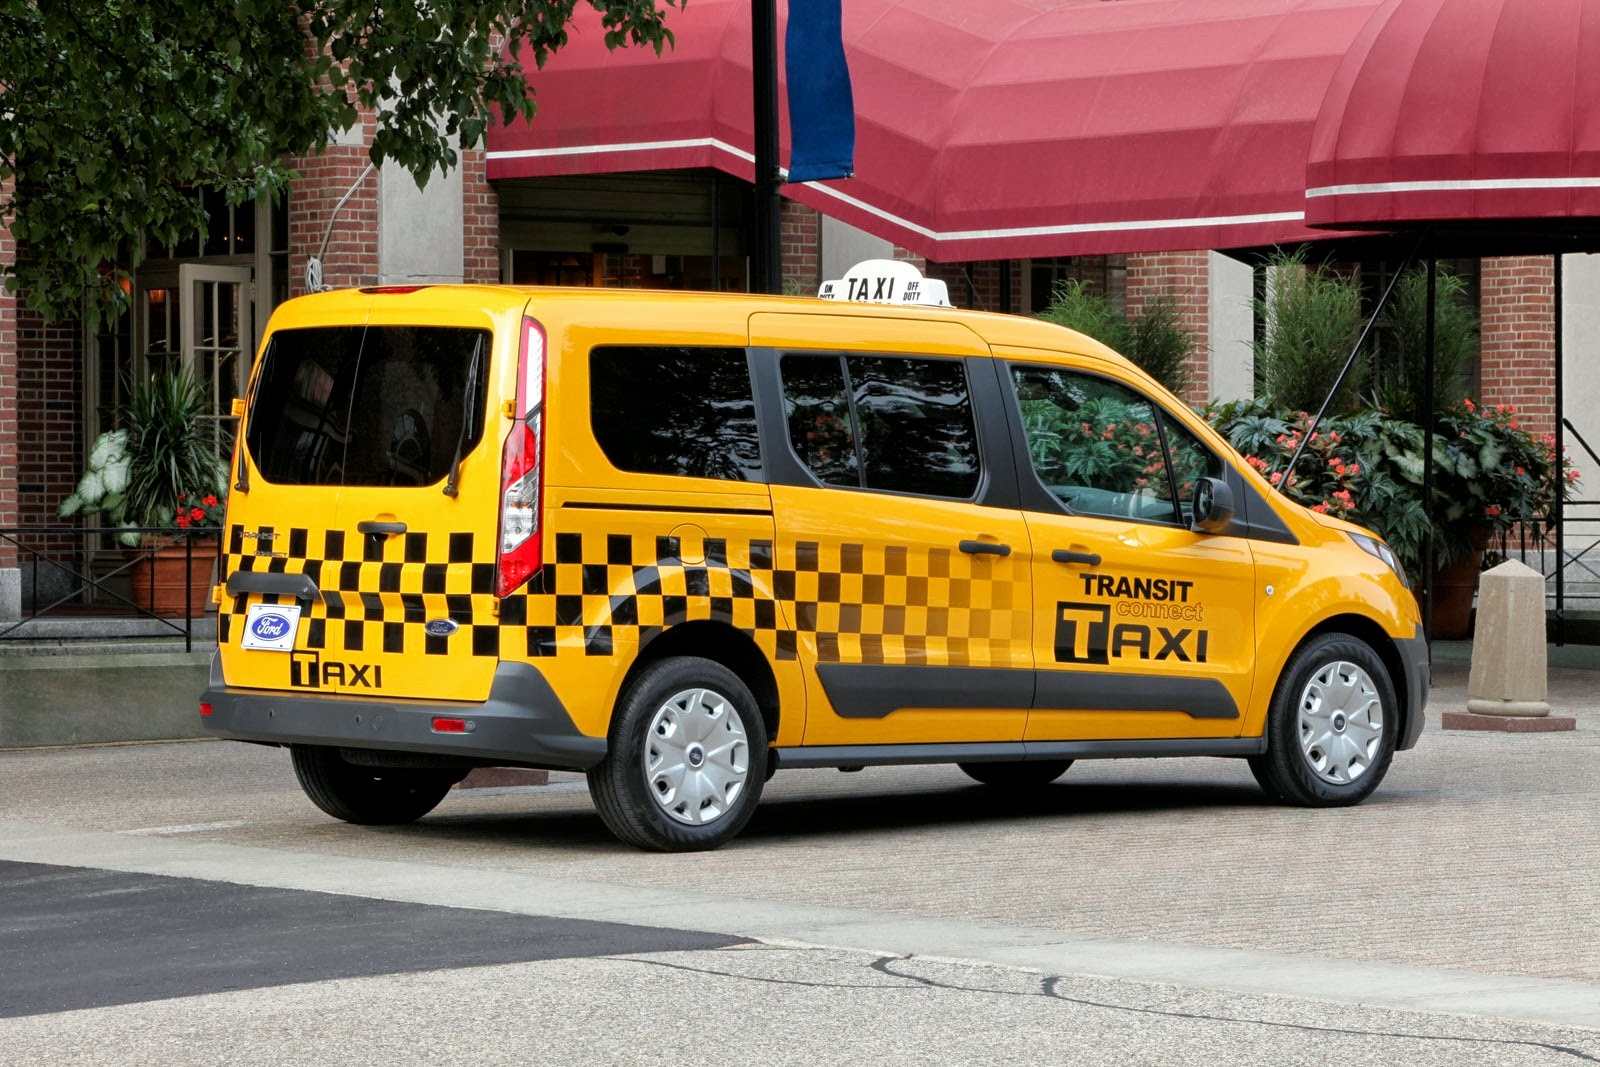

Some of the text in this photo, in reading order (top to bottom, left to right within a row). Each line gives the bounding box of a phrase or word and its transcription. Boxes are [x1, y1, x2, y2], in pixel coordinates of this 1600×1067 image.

[824, 284, 833, 293] ON
[848, 277, 895, 300] TAXI
[903, 291, 921, 301] DUTY
[907, 281, 919, 291] OFF
[1079, 573, 1193, 602] TRANSIT
[1116, 601, 1203, 621] connect
[257, 617, 282, 636] Ford
[1054, 601, 1208, 665] TAXI
[291, 651, 382, 688] TAXI
